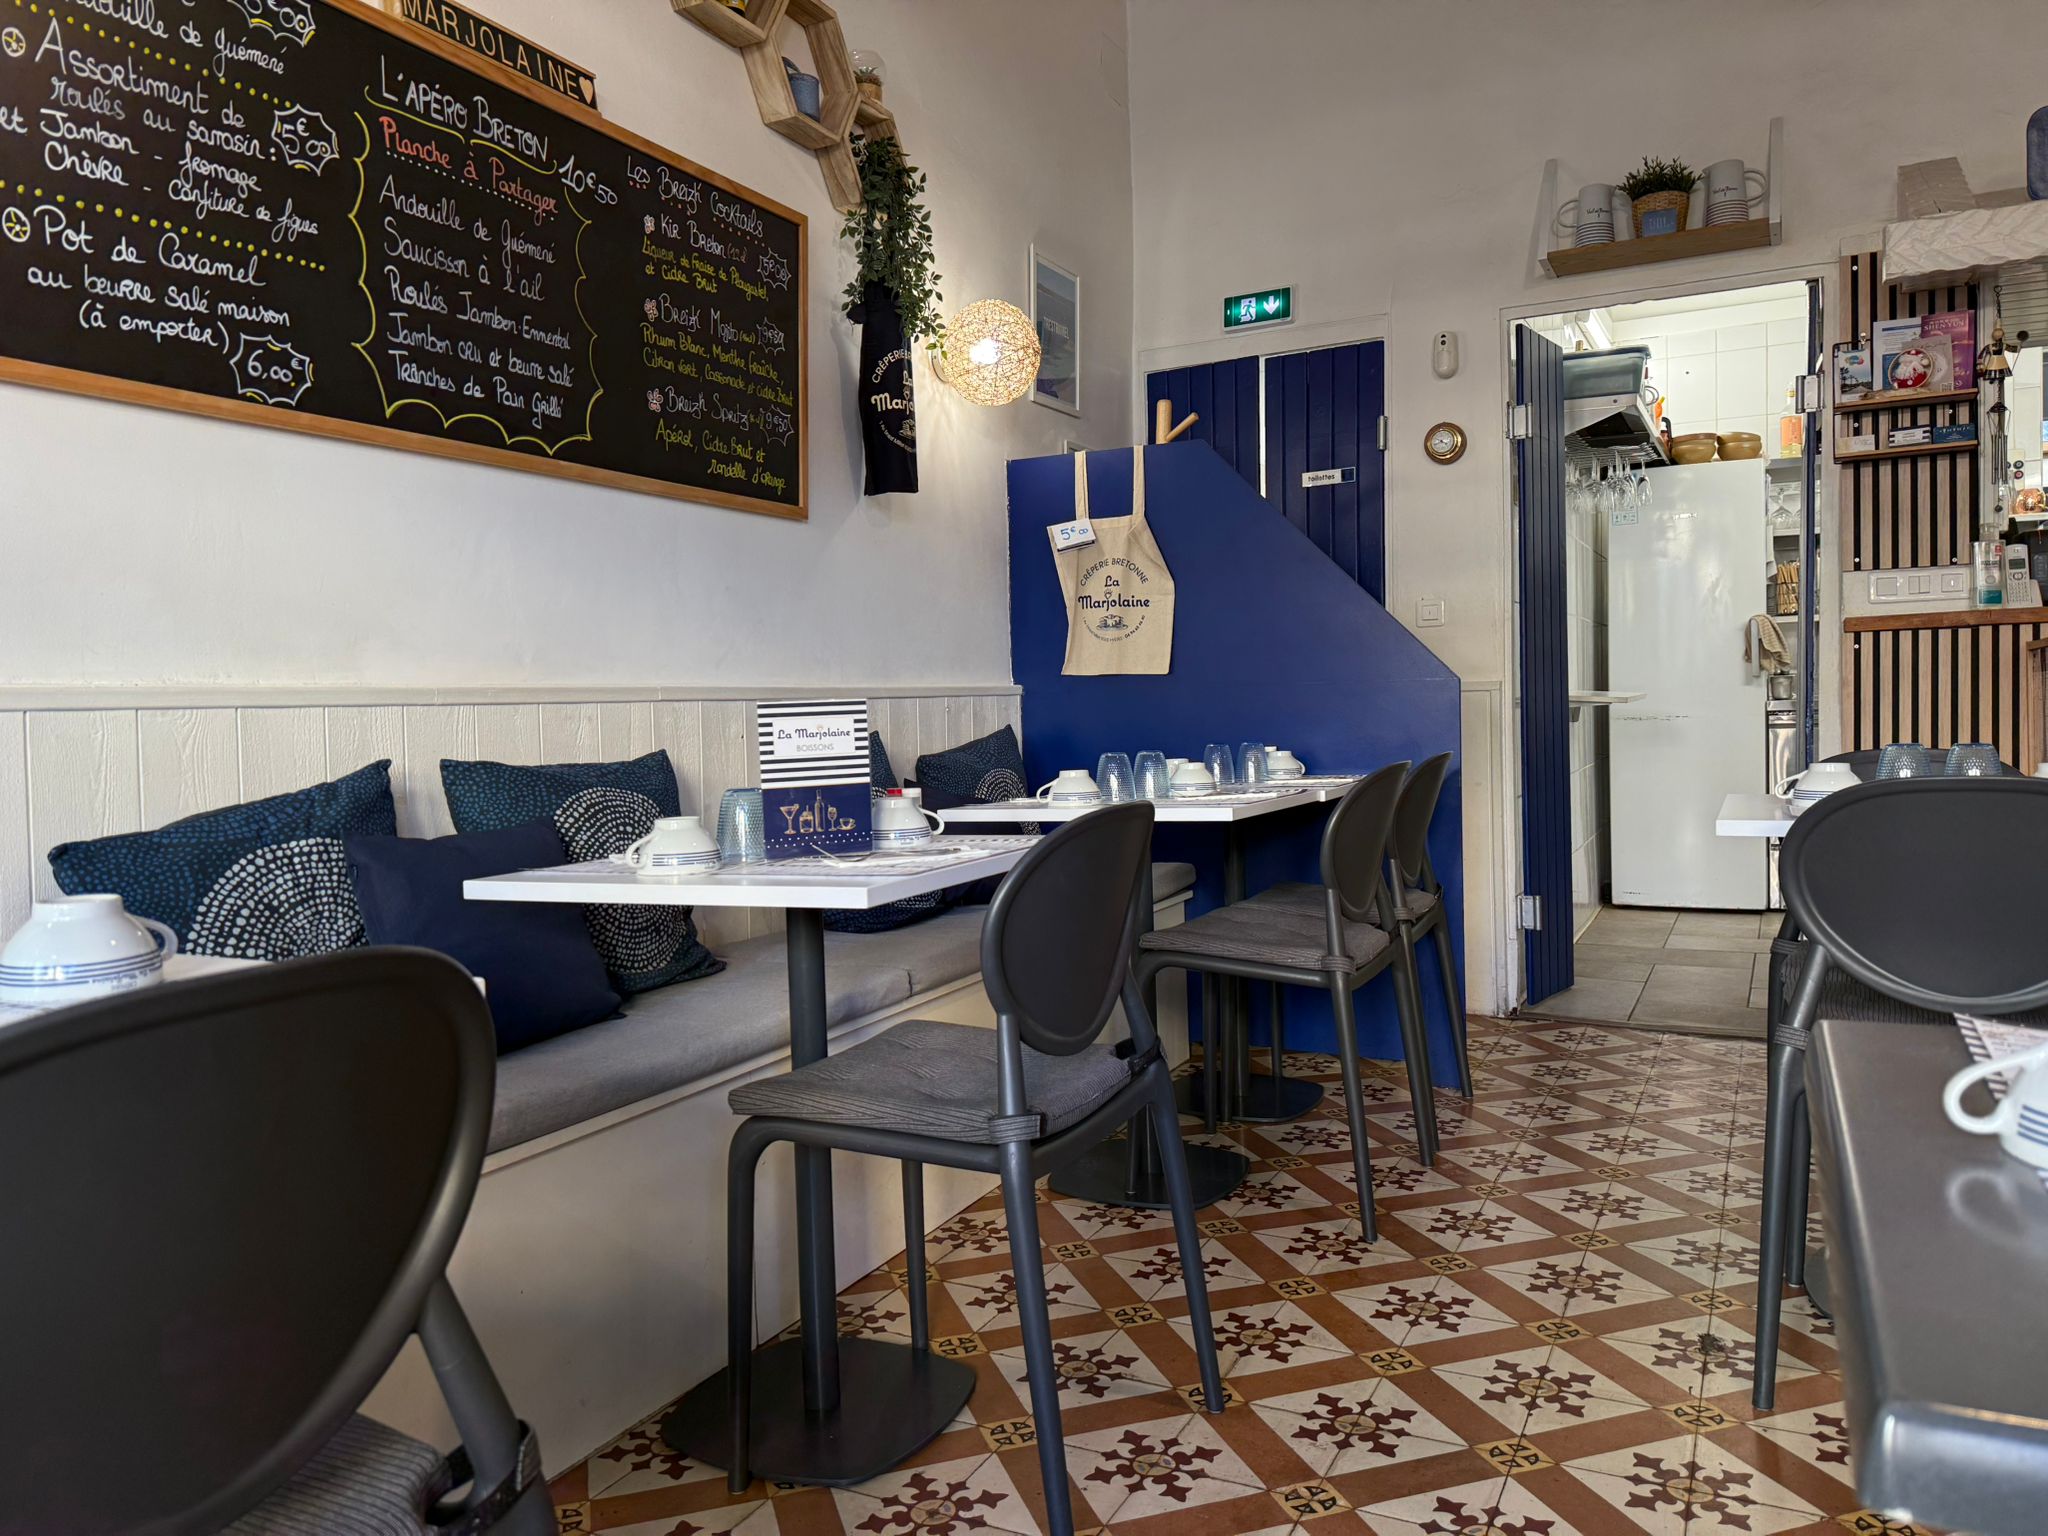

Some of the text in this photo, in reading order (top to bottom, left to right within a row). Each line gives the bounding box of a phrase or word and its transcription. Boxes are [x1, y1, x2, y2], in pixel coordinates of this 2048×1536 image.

[179, 21, 203, 47] de
[402, 0, 580, 100] MARJOLAINE
[0, 106, 28, 136] et
[40, 107, 139, 154] Jambon
[143, 109, 175, 132] au
[222, 100, 245, 128] de
[378, 116, 452, 169] Planche
[463, 151, 479, 181] à
[44, 141, 129, 187] Chèvre
[271, 198, 319, 243] figues
[378, 174, 465, 231] Andouille
[473, 220, 492, 241] de
[33, 204, 266, 286] Pot de Caramel
[384, 216, 471, 278] Saucisson
[478, 254, 491, 285] à
[661, 213, 682, 240] Kir
[27, 266, 72, 289] au
[217, 296, 290, 327] maison
[384, 265, 448, 314] Roulés
[387, 312, 453, 355] Jambon
[489, 347, 502, 368] et
[388, 349, 456, 392] Tranches
[463, 375, 485, 398] de
[492, 376, 525, 409] Pain
[1080, 557, 1149, 587] CRÊPERIE BRETONNE
[1104, 575, 1120, 588] La
[1078, 593, 1150, 612] Marjolaine
[777, 725, 851, 741] La Marjolaine
[796, 743, 835, 753] BOISSONS
